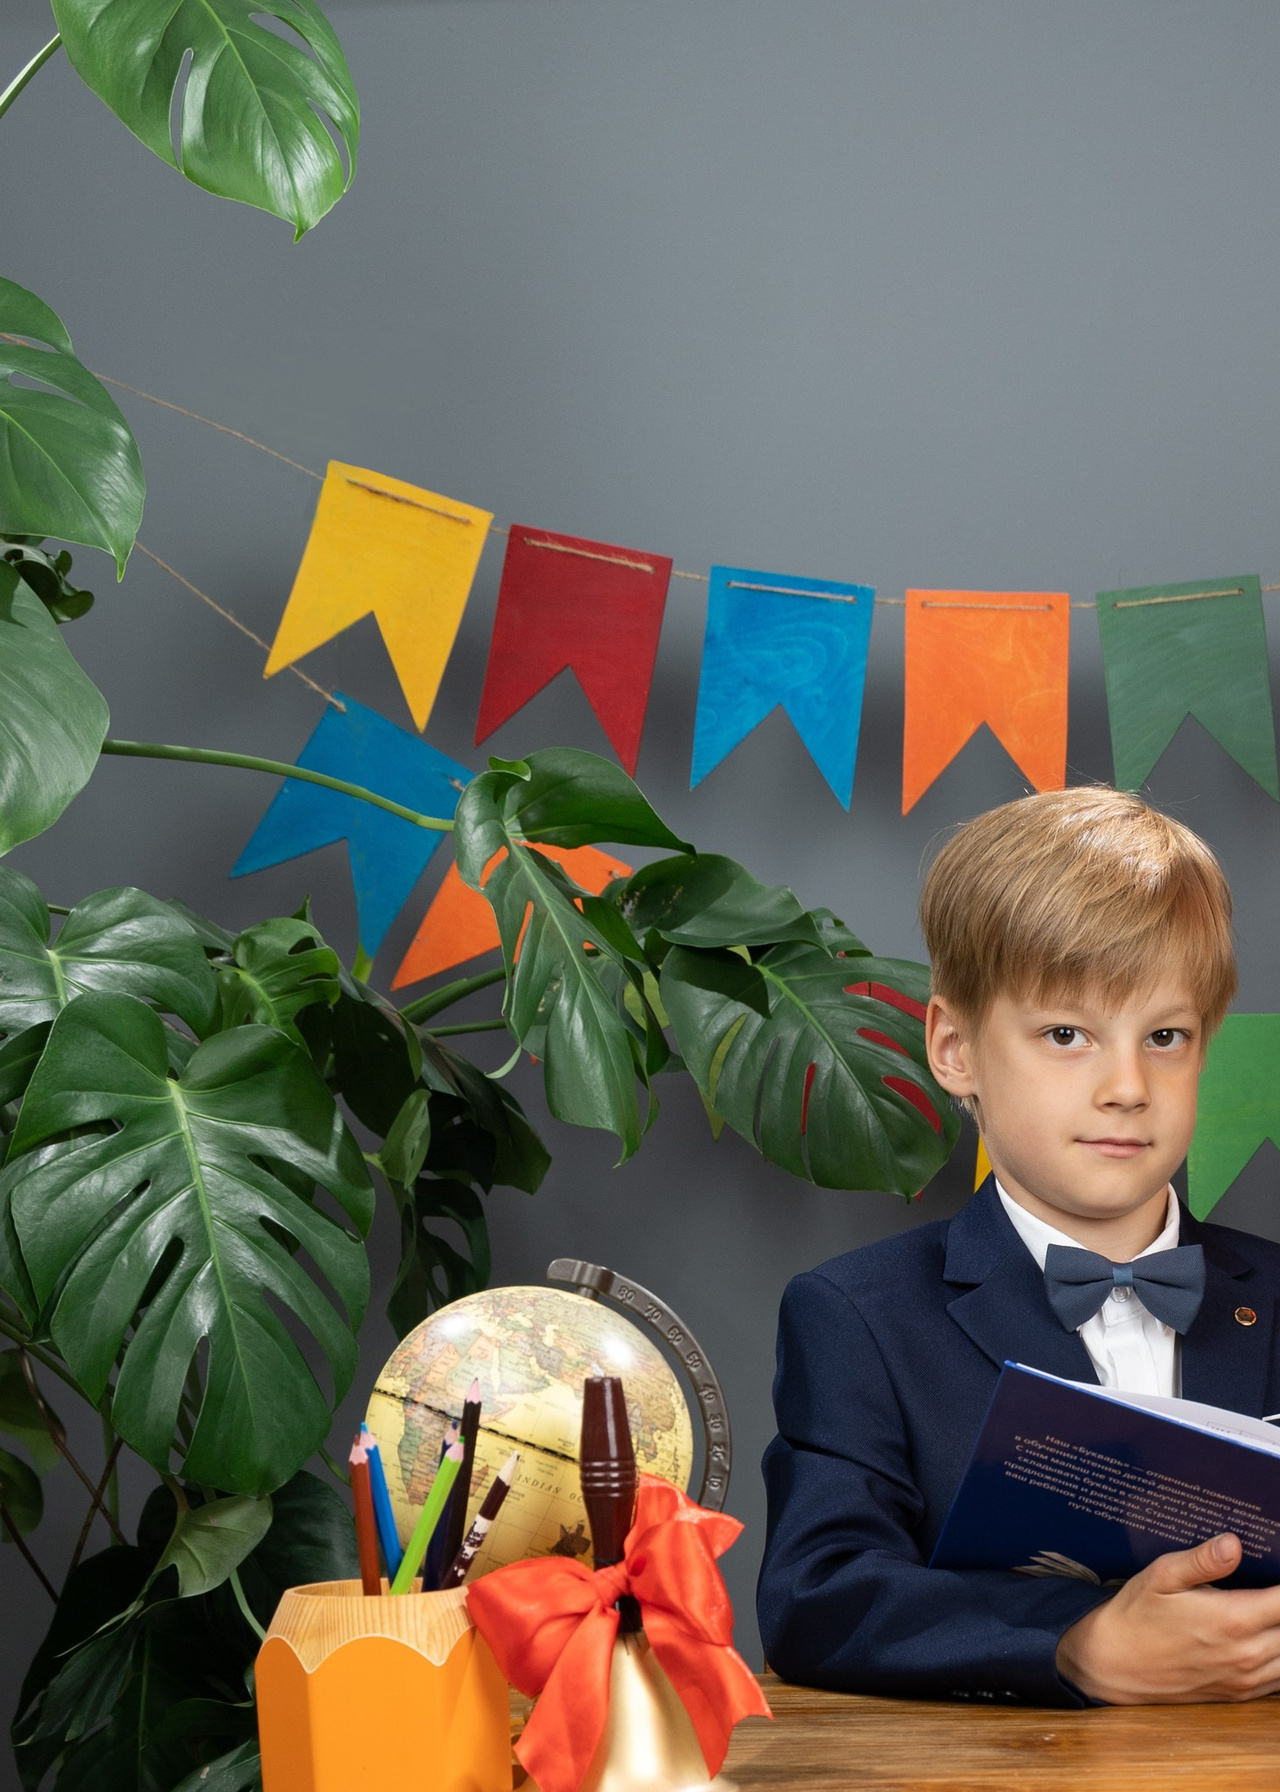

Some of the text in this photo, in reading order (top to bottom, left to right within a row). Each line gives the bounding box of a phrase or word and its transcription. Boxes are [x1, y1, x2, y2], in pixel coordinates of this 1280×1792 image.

[618, 1285, 636, 1302] 80
[644, 1302, 662, 1322] 70
[667, 1325, 685, 1345] 60
[686, 1351, 703, 1371] 50
[709, 1413, 723, 1431] 30
[516, 1474, 562, 1494] INDIAN
[709, 1475, 721, 1491] 10
[1023, 1438, 1077, 1461] обучении
[1079, 1458, 1122, 1475] чтению
[1122, 1472, 1156, 1487] детей
[1156, 1483, 1231, 1511] дошкольного
[1045, 1435, 1070, 1448] Наш
[1072, 1445, 1130, 1468] «Букварь»
[1146, 1470, 1201, 1492] отличный
[1202, 1488, 1262, 1512] помощник
[1004, 1460, 1079, 1490] предложения
[1089, 1490, 1142, 1511] рассказы.
[1145, 1507, 1198, 1529] Страница
[1200, 1526, 1212, 1534] за
[1005, 1471, 1195, 1537] ваш ребёнок пройдёт сложный, но
[1017, 1456, 1081, 1481] складывать
[1083, 1477, 1118, 1493] буквы
[1128, 1492, 1161, 1508] слоги,
[1163, 1505, 1178, 1513] но
[1230, 1526, 1266, 1541] читать
[1025, 1449, 1048, 1460] ним
[1050, 1457, 1090, 1474] малыш
[1092, 1471, 1106, 1479] не
[1108, 1476, 1145, 1493] только
[1147, 1489, 1185, 1506] выучит
[1188, 1502, 1225, 1519] буквы,
[1227, 1516, 1276, 1536] научится
[1068, 1501, 1193, 1545] путь обучения чтению!
